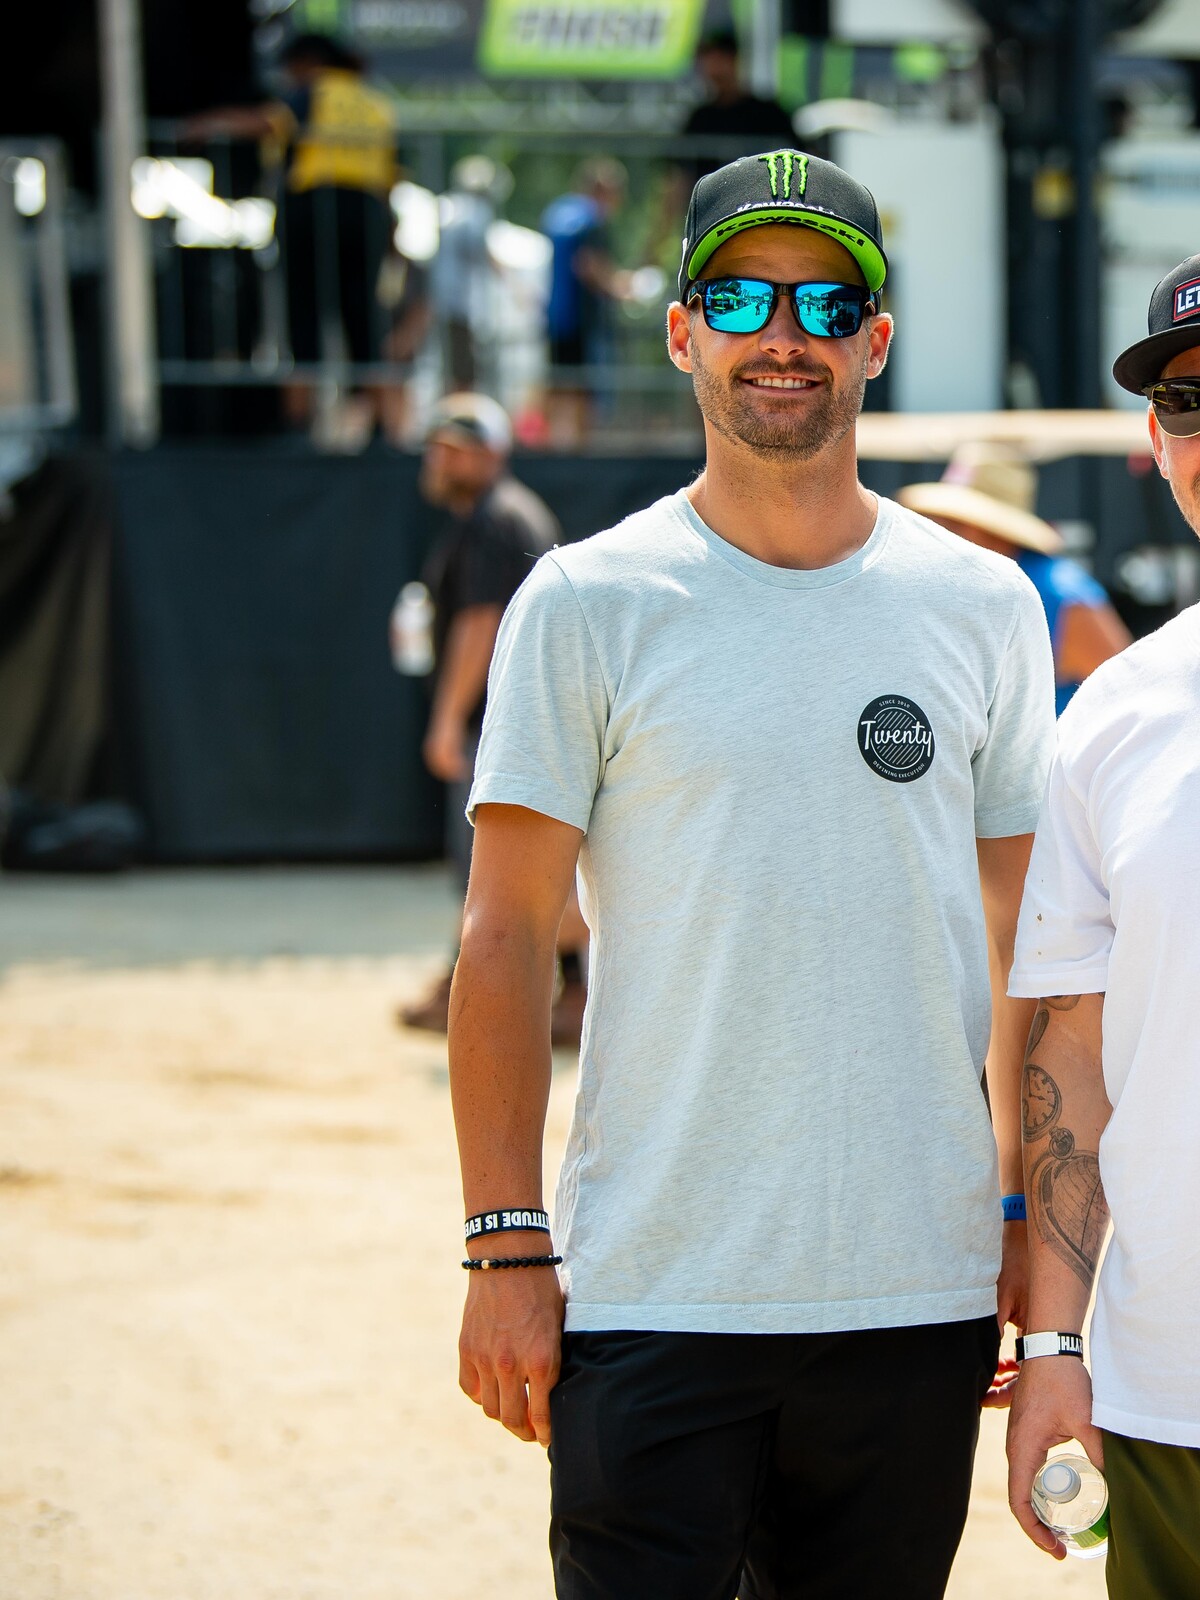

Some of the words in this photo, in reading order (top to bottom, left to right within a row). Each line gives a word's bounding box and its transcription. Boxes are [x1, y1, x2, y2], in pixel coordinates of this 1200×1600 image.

[716, 216, 866, 247] Kawasaki
[879, 699, 895, 707] SINCE
[861, 720, 931, 757] Twenty
[873, 760, 897, 778] DEFINING
[898, 763, 925, 778] EXECUTION
[485, 1213, 498, 1230] IS
